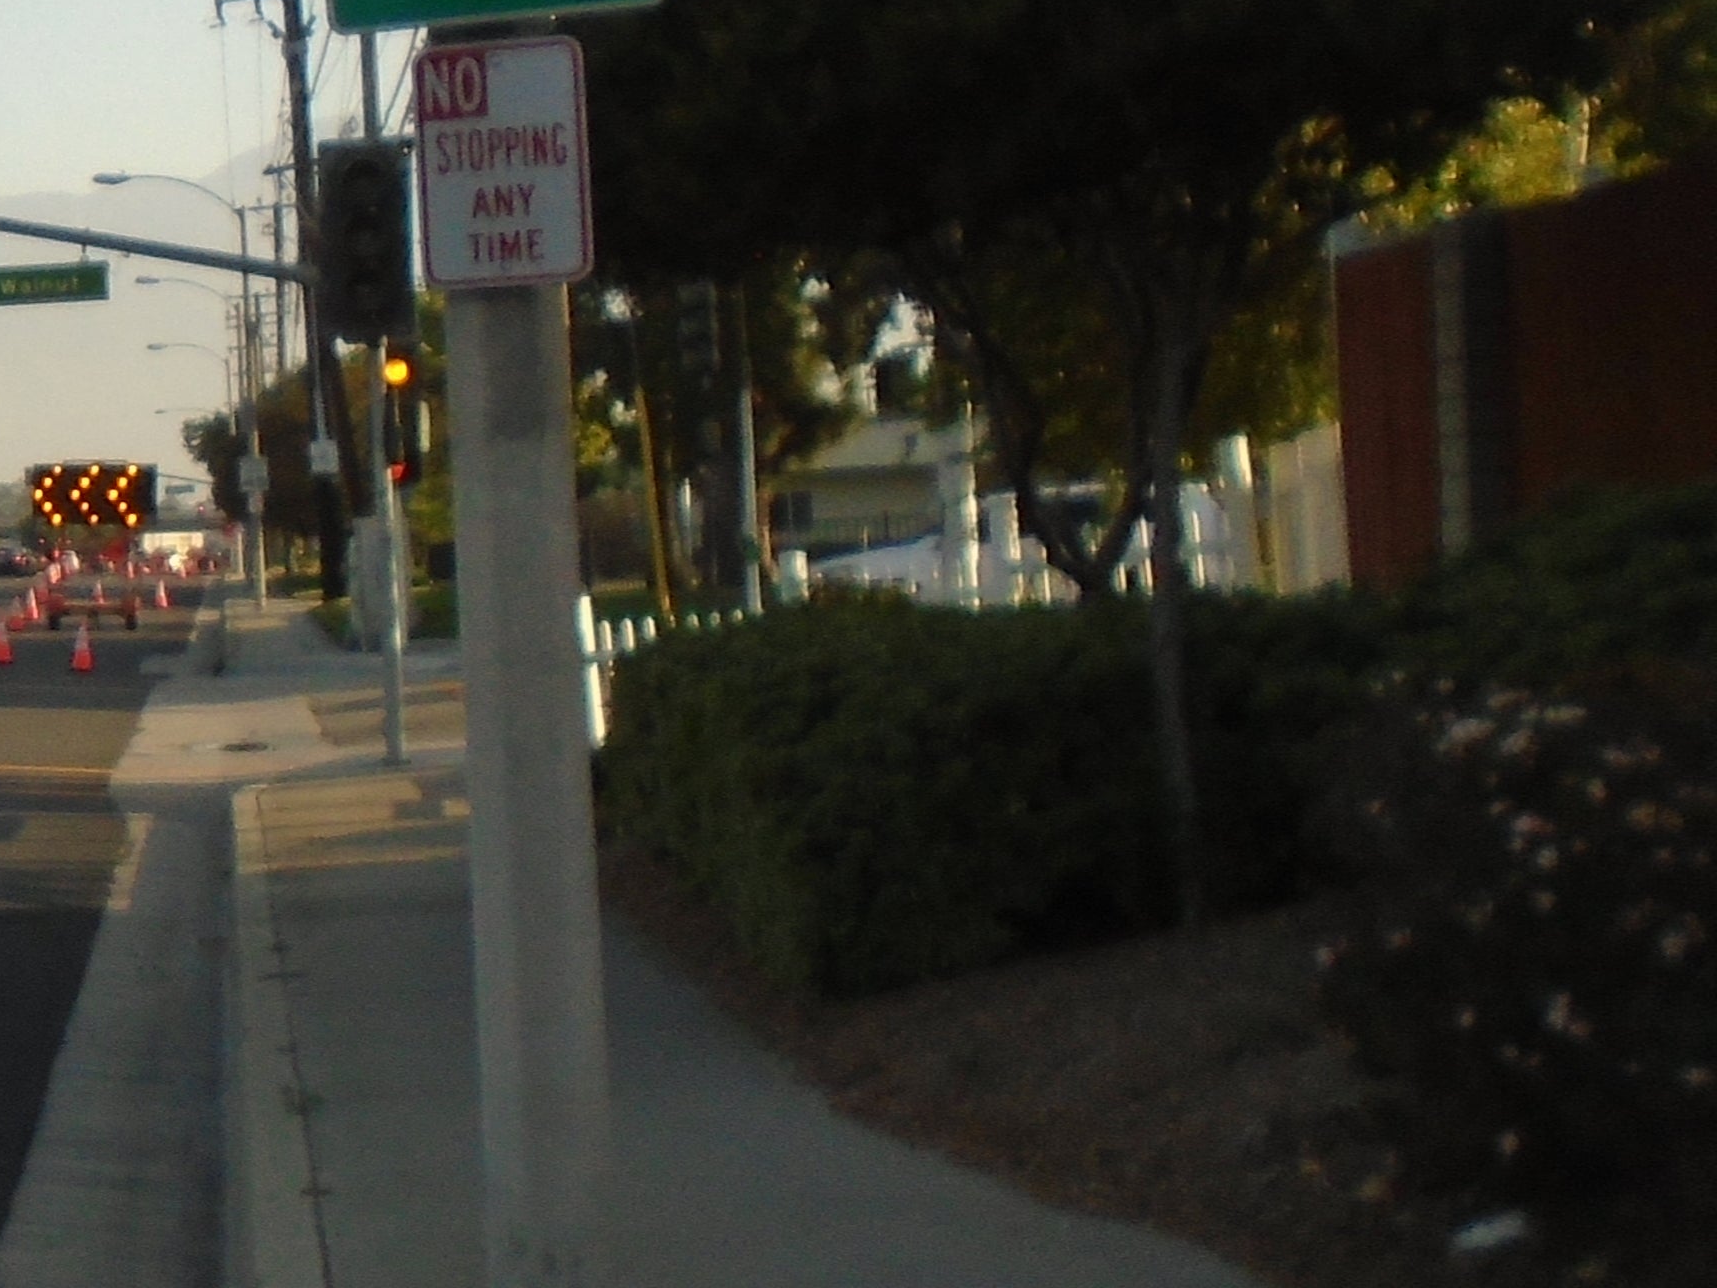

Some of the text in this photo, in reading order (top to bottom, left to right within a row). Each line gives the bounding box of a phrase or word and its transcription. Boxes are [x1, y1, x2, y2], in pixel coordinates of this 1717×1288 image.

[422, 56, 483, 114] NO
[435, 122, 568, 175] STOPPING
[473, 183, 536, 219] ANY
[468, 228, 545, 263] TIME
[0, 275, 80, 295] Walnut
